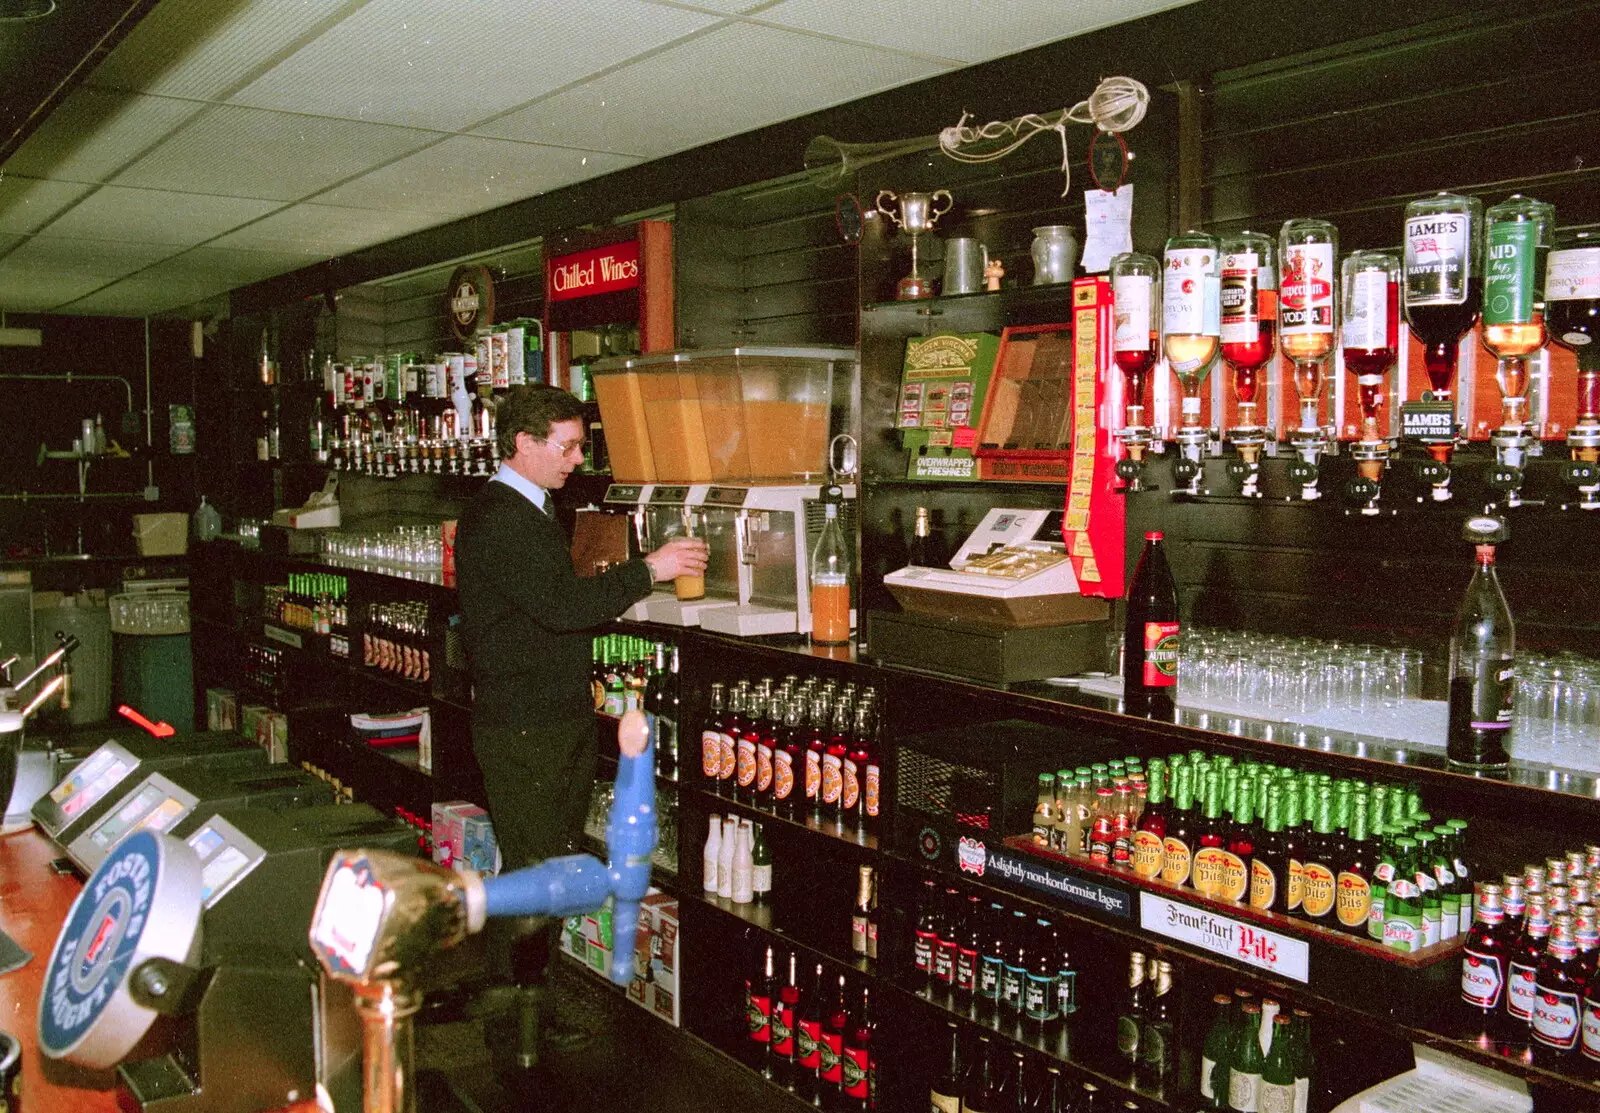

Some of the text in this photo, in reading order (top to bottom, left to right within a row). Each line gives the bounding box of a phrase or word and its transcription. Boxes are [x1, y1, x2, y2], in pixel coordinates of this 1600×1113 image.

[1409, 222, 1458, 237] LAMB'S
[1489, 243, 1517, 260] GIN
[553, 255, 638, 292] Chilled Wines
[1408, 263, 1458, 275] NAVY RUM
[941, 339, 971, 358] VIRGINIA
[1403, 413, 1451, 426] LAMB'S
[1404, 427, 1451, 435] NAVY RUM
[917, 456, 974, 468] OVERWRAPPED
[928, 467, 972, 476] FRESHNESS
[1136, 852, 1155, 864] Pils
[988, 856, 996, 867] A
[996, 857, 1026, 882] slightly
[1098, 889, 1123, 911] lager.
[1252, 884, 1264, 894] ils
[1304, 886, 1326, 899] Pils
[1339, 896, 1362, 908] Pils
[1166, 904, 1279, 962] Frankfurt Pils
[1512, 984, 1535, 998] MOLS
